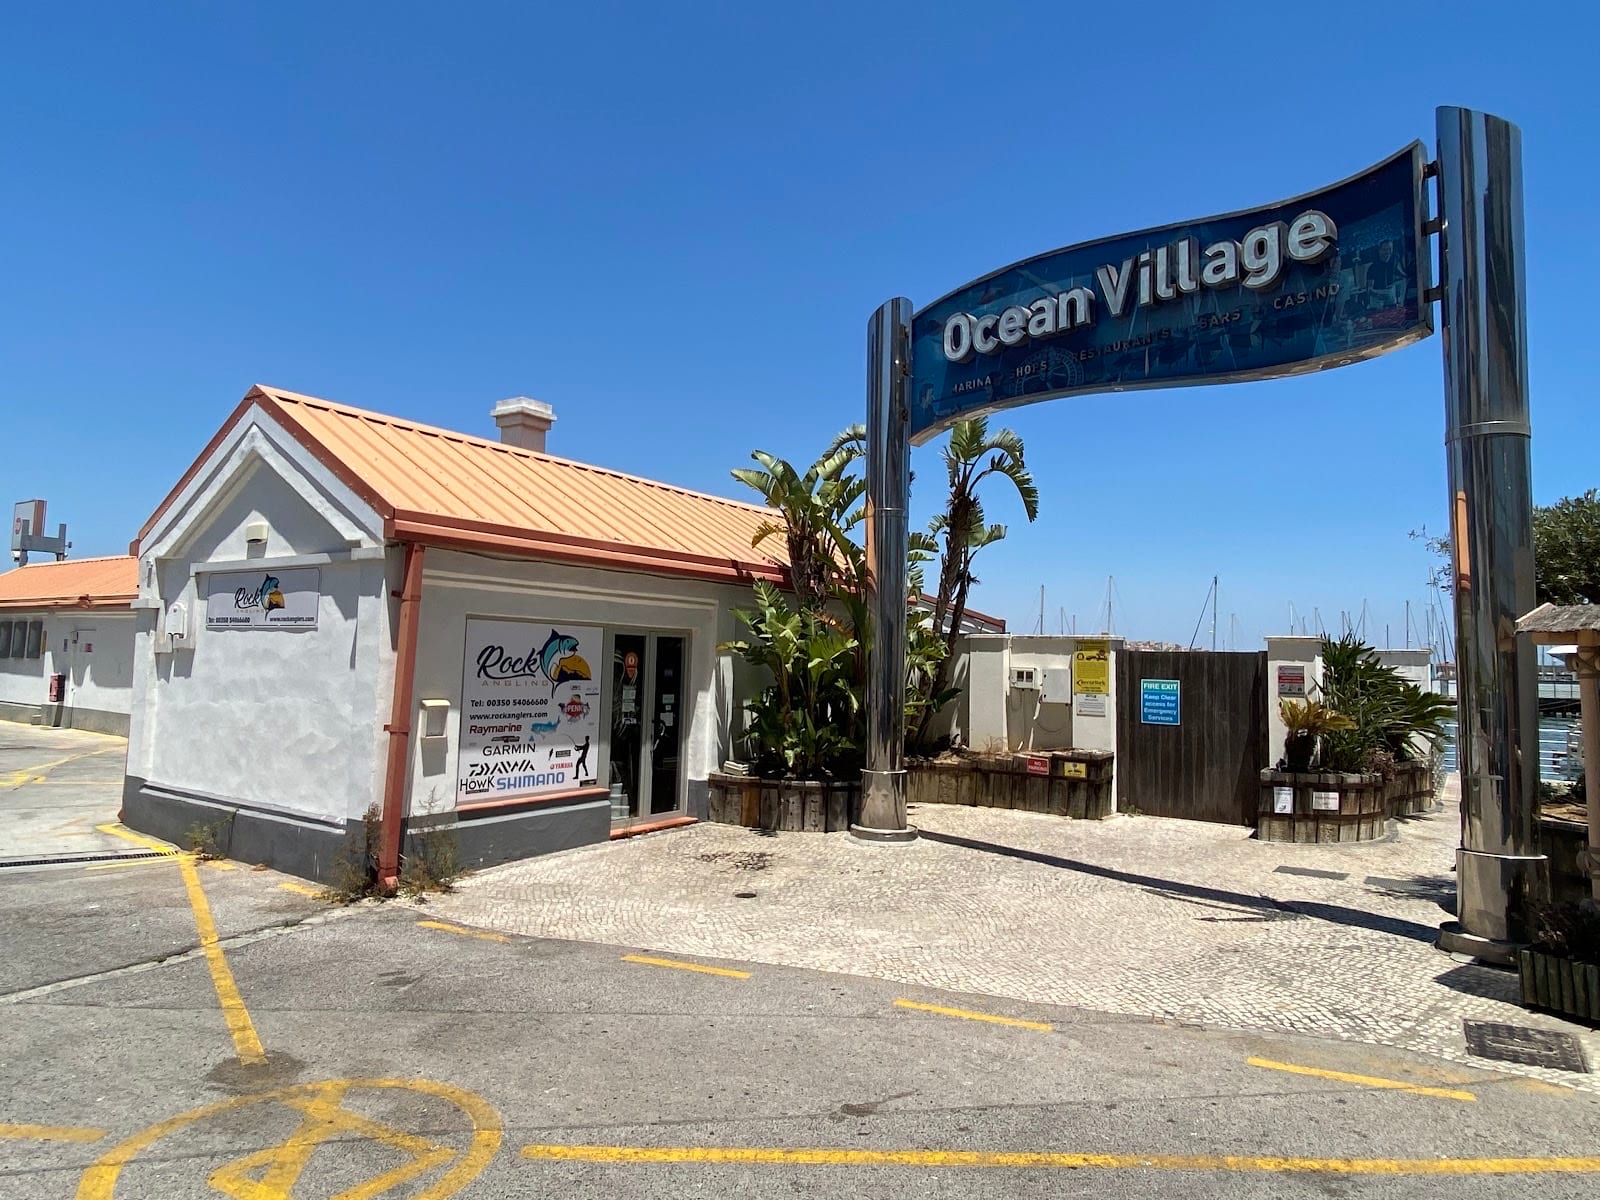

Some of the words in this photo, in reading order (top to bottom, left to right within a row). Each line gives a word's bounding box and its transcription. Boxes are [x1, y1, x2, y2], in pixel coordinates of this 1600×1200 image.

[943, 286, 1095, 362] Ocean
[1097, 209, 1338, 318] Village
[234, 587, 260, 609] Rock
[476, 645, 540, 680] Rock
[1143, 682, 1160, 690] FIRE
[470, 699, 484, 707] Tel:
[486, 699, 511, 707] 00350
[469, 711, 548, 721] www.rockanglers.com
[1144, 707, 1177, 715] Emergency
[469, 723, 522, 736] Raymarine
[482, 743, 536, 756] GARMIN
[469, 759, 535, 777] DAIWA
[496, 771, 565, 791] SHIMANO
